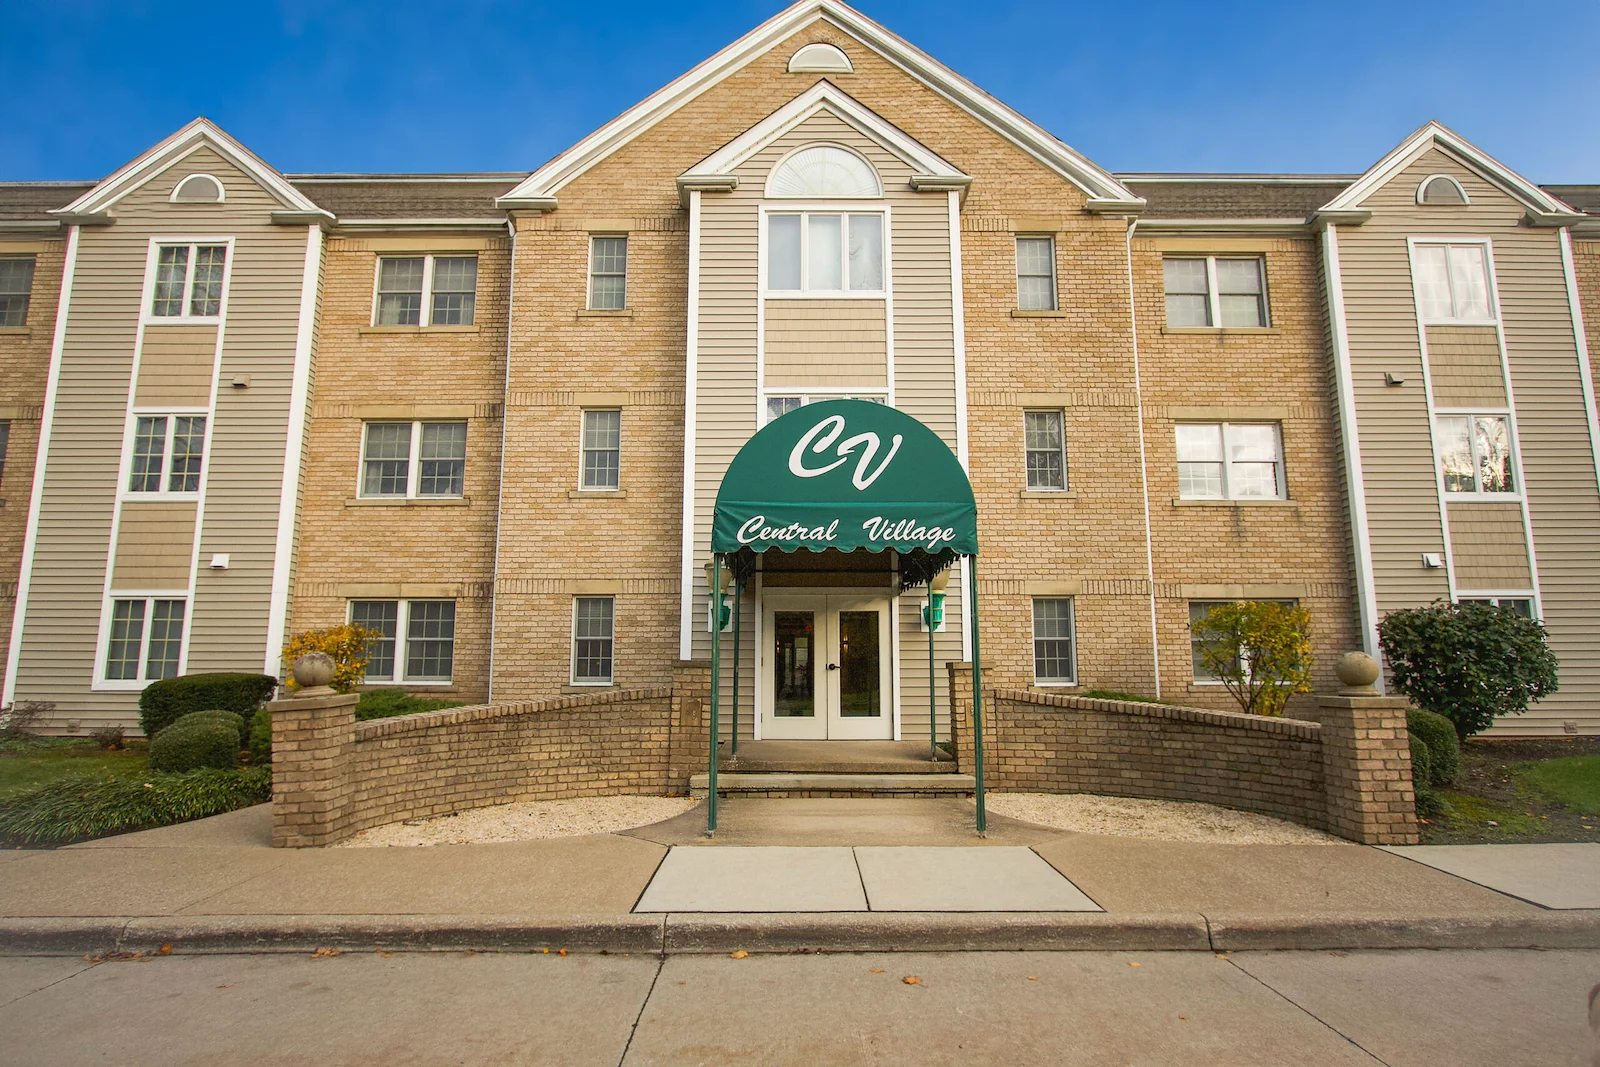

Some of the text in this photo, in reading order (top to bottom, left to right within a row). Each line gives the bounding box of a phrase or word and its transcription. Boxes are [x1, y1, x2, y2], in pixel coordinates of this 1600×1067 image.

[788, 414, 903, 491] CV
[736, 515, 956, 549] Central Village
